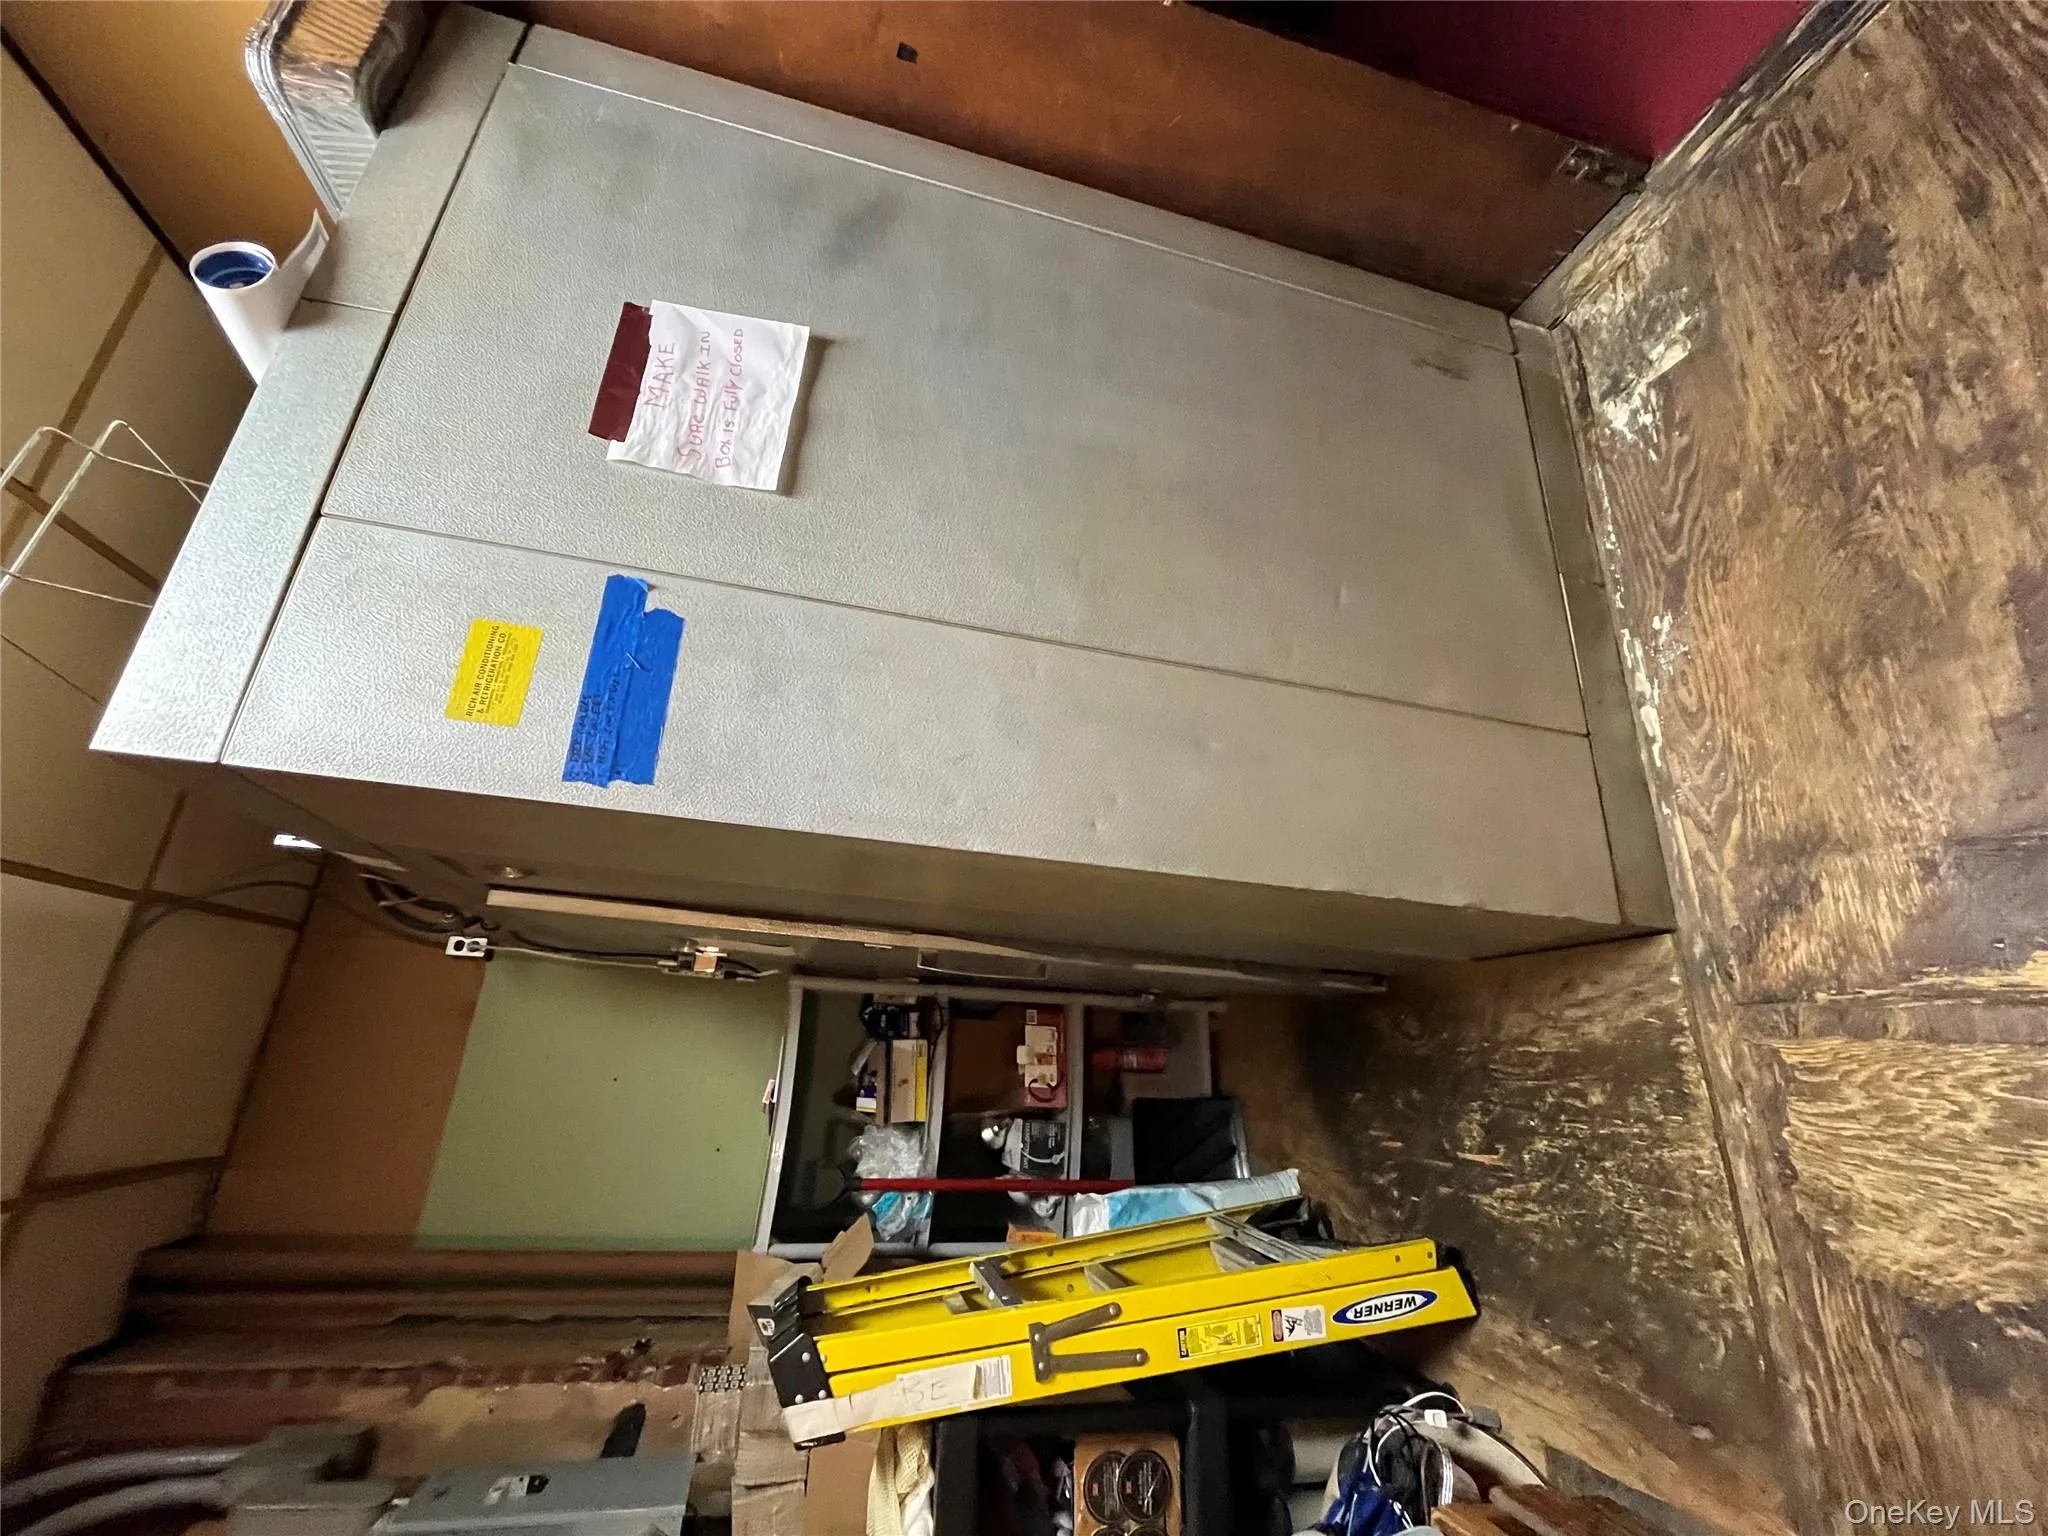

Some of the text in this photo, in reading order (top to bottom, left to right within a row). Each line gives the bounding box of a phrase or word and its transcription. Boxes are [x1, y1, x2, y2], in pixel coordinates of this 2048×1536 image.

[700, 331, 711, 357] IN
[643, 343, 675, 407] MAKE
[715, 439, 731, 468] Box
[723, 420, 735, 432] is
[465, 698, 477, 716] RICH
[472, 682, 482, 695] AIR
[477, 625, 499, 680] CONDITIONING
[479, 646, 502, 705] REFRIGERATION
[1353, 1296, 1417, 1319] WERNER
